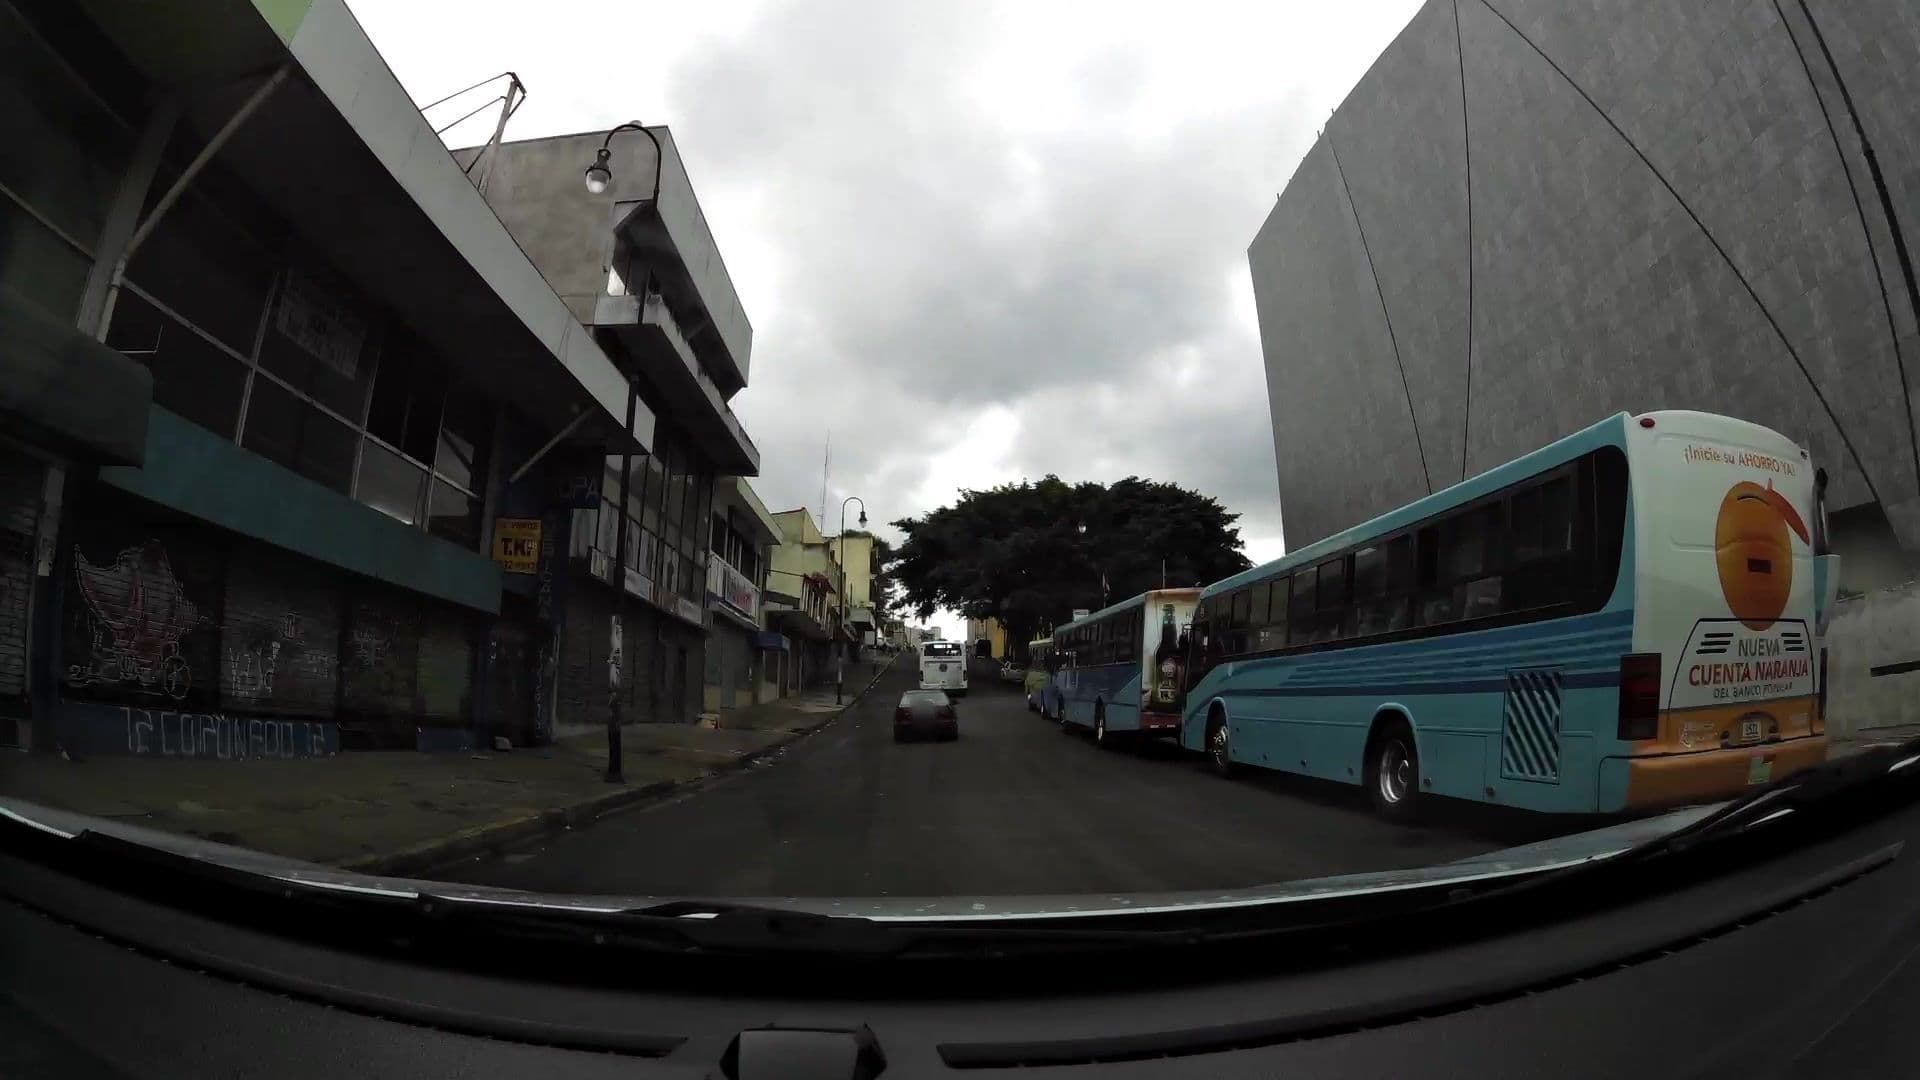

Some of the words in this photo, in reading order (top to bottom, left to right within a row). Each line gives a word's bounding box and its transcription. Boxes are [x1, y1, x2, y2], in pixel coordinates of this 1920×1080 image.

[1723, 453, 1736, 465] su
[1739, 451, 1781, 474] AHORRO
[1738, 637, 1781, 657] NUEVA
[1688, 661, 1753, 687] CUENTA
[1755, 658, 1809, 681] NARANJA
[1713, 687, 1730, 699] DEL
[1733, 684, 1761, 698] BANCO
